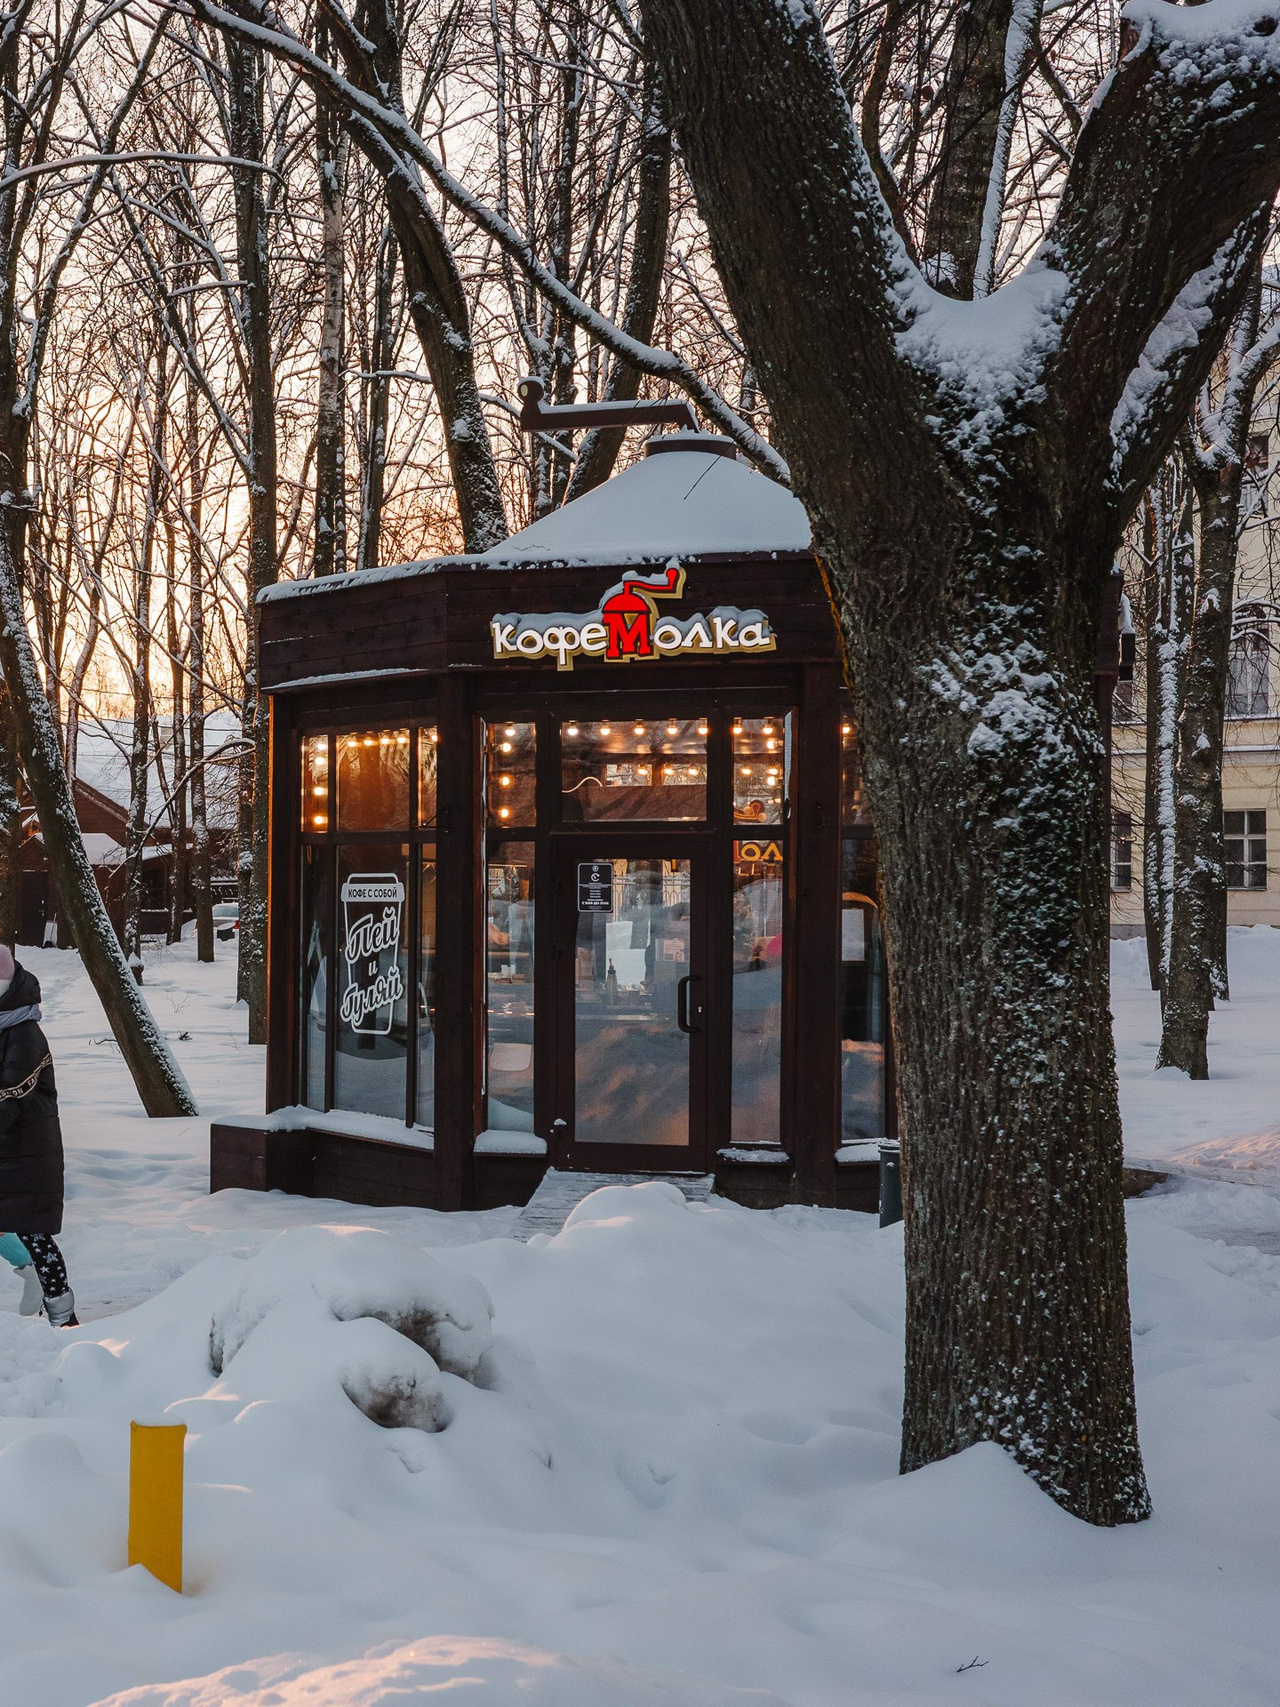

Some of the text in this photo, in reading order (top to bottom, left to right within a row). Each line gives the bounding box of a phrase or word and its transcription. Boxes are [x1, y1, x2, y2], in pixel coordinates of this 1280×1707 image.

[348, 887, 398, 898] КОФЕ С СОБОЙ
[345, 906, 400, 964] Пей
[368, 960, 379, 977] и
[340, 965, 404, 1027] Гуляй
